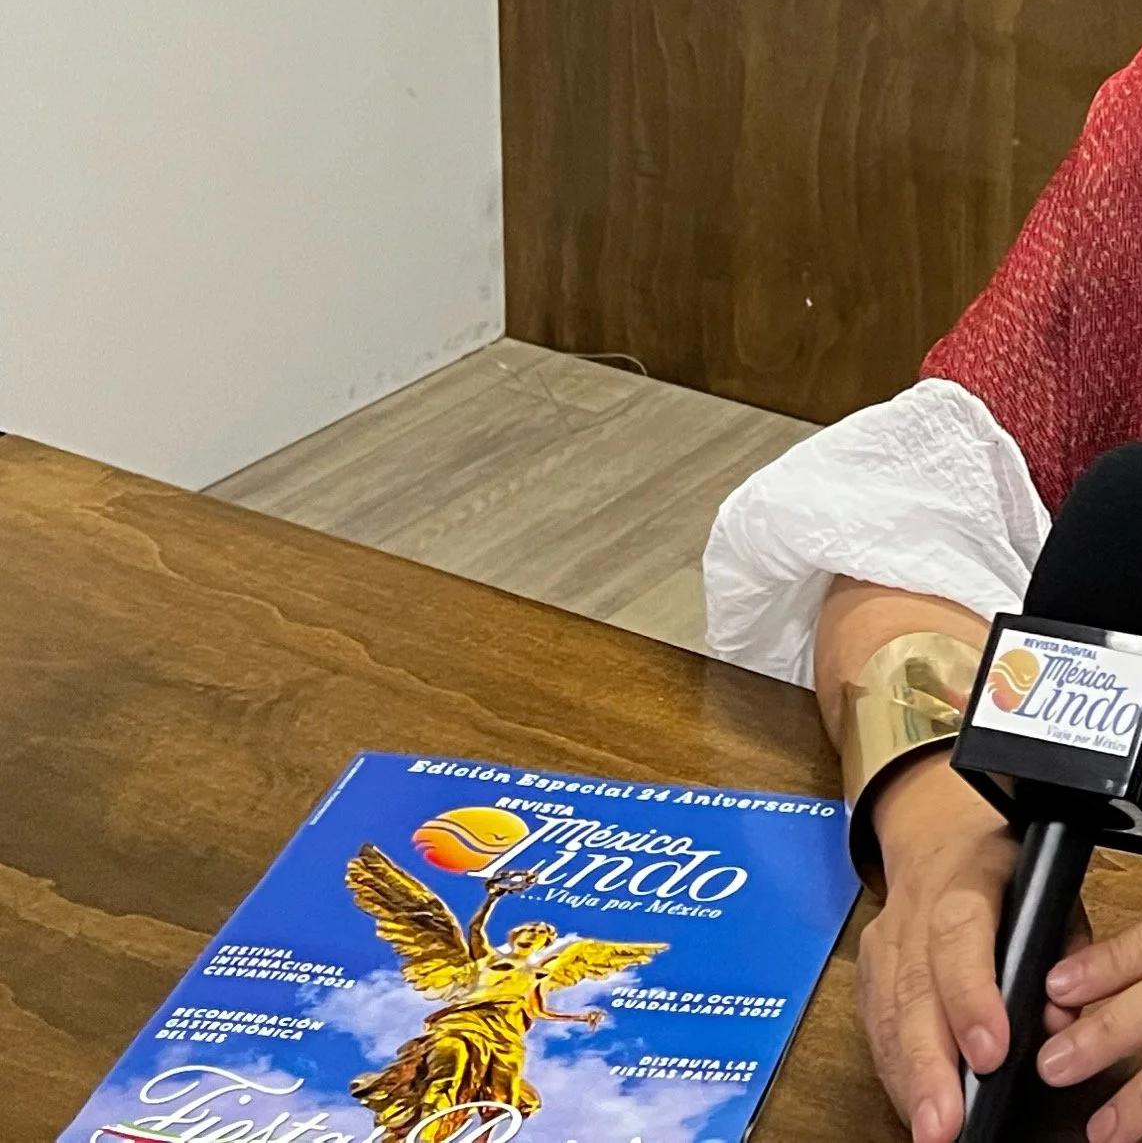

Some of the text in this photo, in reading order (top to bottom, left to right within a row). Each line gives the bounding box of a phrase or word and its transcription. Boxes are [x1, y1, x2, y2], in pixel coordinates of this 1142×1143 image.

[1023, 638, 1060, 653] REVISTA
[1046, 655, 1118, 691] México
[1012, 654, 1140, 736] Lindo
[408, 760, 835, 818] Edición Especial 24 Aniversario
[495, 797, 575, 816] REVISTA
[541, 815, 696, 855] México
[467, 814, 748, 902] Lindo
[601, 898, 643, 912] por
[645, 899, 722, 919] México
[218, 945, 293, 959] FESTIVAL
[203, 966, 310, 984] CERVANTINO
[210, 955, 344, 976] INTERNACIONAL
[612, 986, 787, 1007] FIESTAS DE OCTUBRE
[611, 998, 783, 1018] GUADALAJARA 2025
[165, 1018, 303, 1041] GASTRONÓMICA
[172, 1007, 325, 1031] RECOMENDACIÓN
[155, 1029, 228, 1044] DEL MES
[609, 1065, 753, 1082] FIESTAS PATRIAS
[639, 1056, 758, 1071] DISFRUTA LAS
